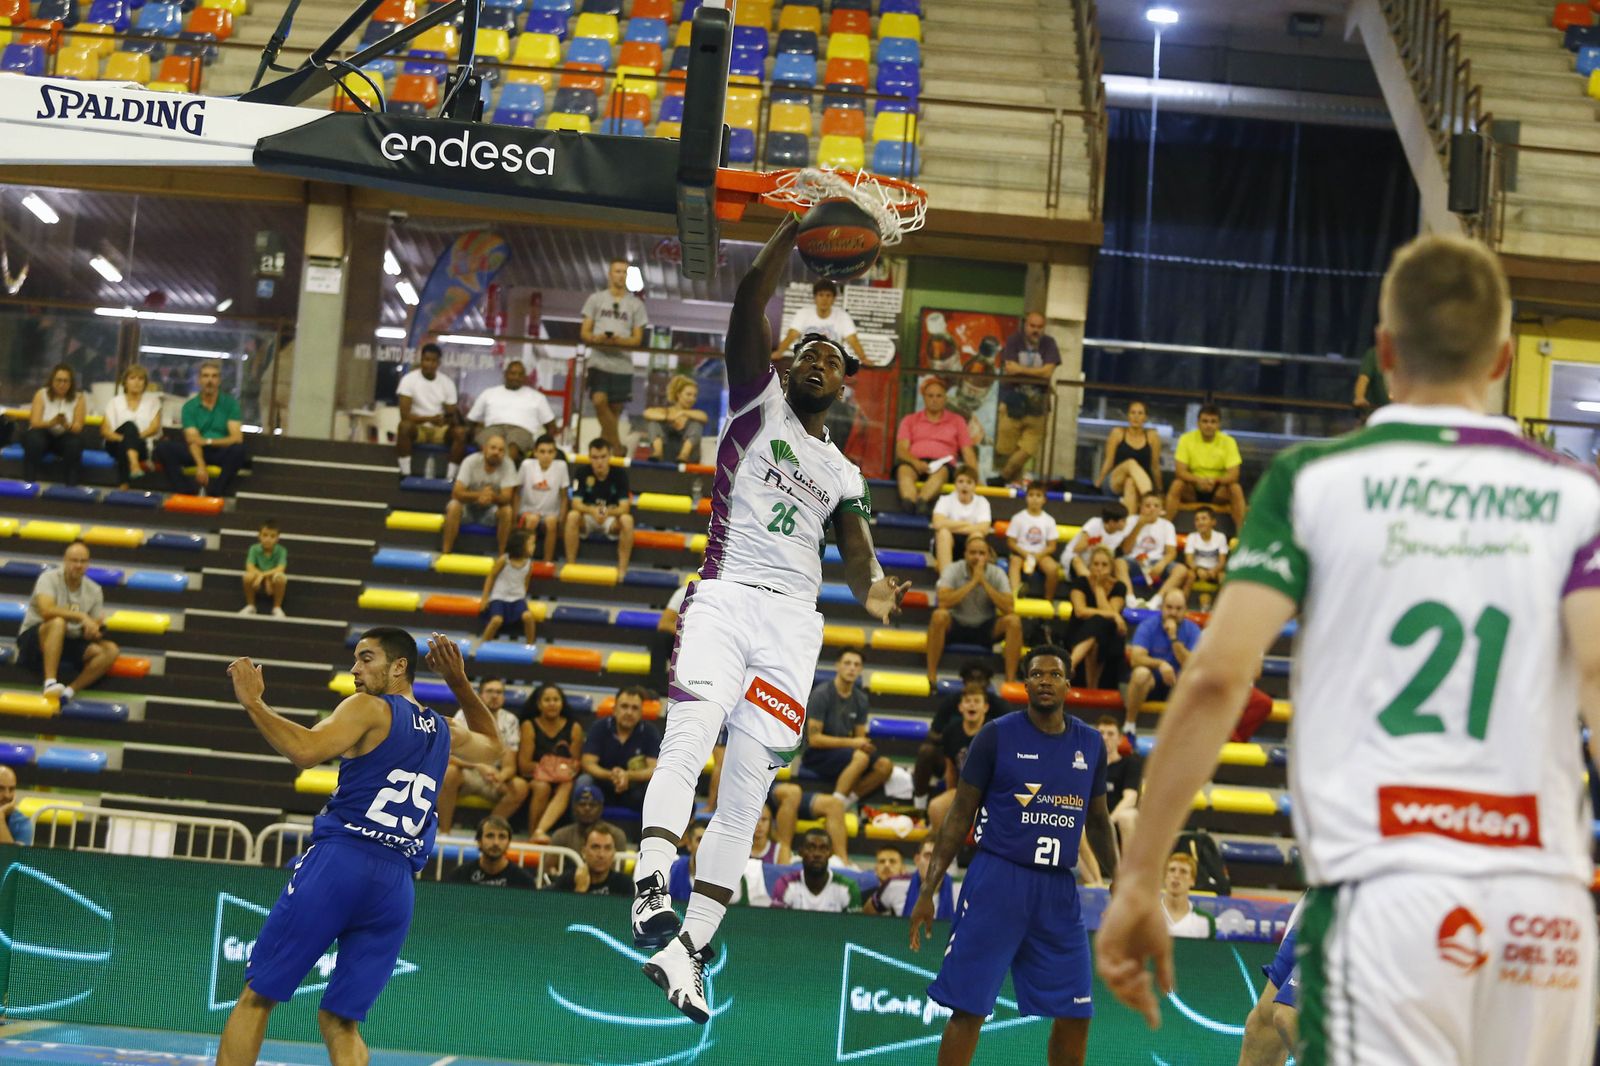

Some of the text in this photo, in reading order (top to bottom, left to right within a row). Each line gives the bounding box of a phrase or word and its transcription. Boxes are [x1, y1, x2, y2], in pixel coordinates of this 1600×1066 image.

[36, 84, 206, 136] SPALDING
[380, 130, 556, 176] endesa
[767, 502, 798, 536] 26
[1376, 600, 1511, 742] 21
[365, 768, 437, 838] 25
[1021, 811, 1075, 828] BURGOS
[1391, 802, 1531, 840] worten
[1034, 836, 1061, 867] 21
